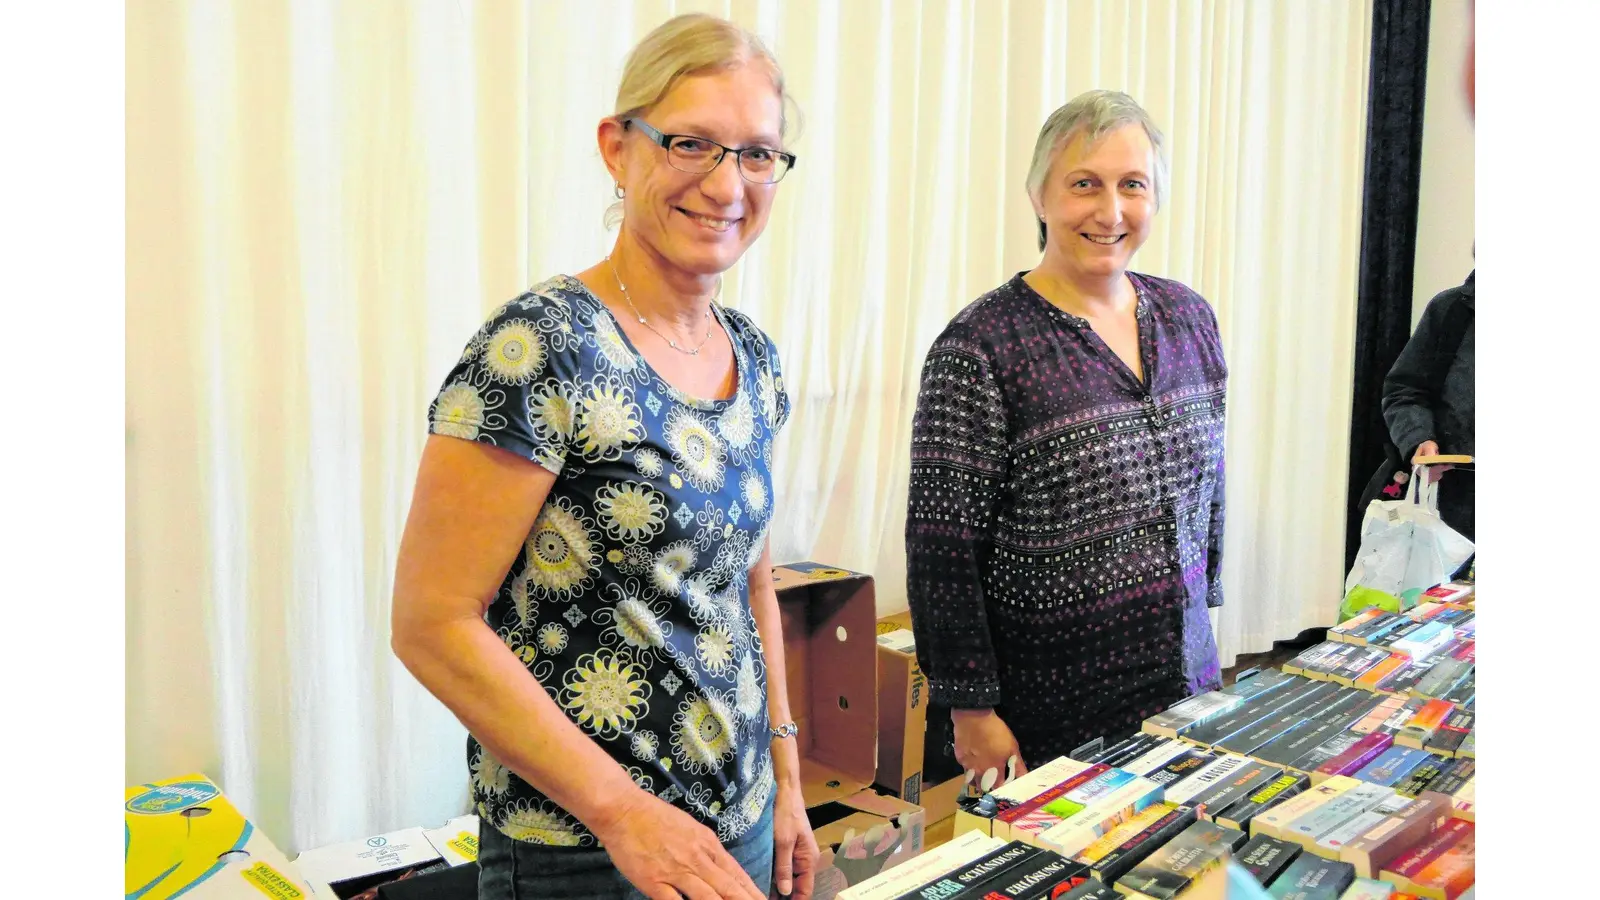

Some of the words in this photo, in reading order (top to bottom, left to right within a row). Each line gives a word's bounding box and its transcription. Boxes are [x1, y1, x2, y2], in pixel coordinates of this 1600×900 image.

[911, 661, 925, 709] yffes
[959, 848, 1026, 882] SCHÄNDUNG
[1005, 862, 1065, 895] ERLÖSUNG
[920, 879, 955, 898] ADLER
[928, 882, 965, 900] OLSEN
